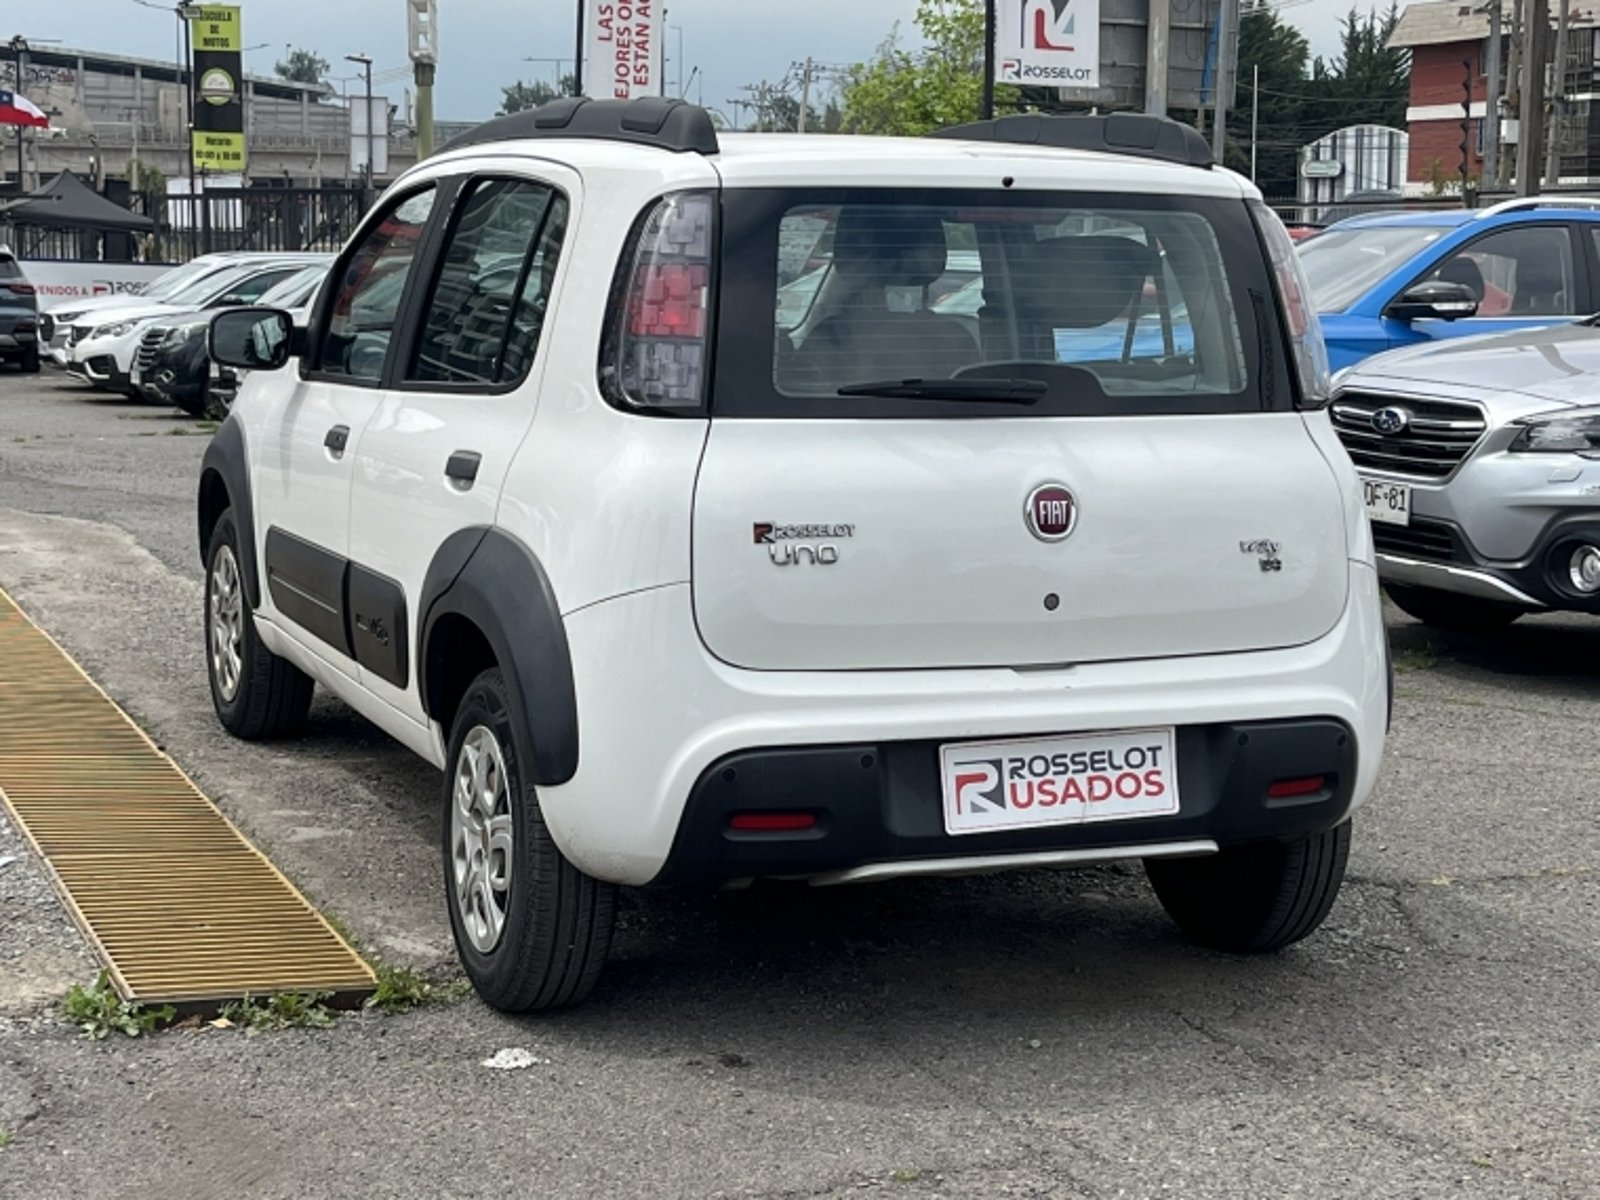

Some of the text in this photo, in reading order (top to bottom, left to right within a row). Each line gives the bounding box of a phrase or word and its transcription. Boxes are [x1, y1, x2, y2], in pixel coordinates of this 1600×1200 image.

[210, 24, 219, 34] DE
[598, 5, 613, 41] LAS
[632, 0, 651, 85] ESTÁN A
[1023, 65, 1091, 80] ROSSELOT
[1040, 500, 1068, 525] FIAT
[1008, 746, 1163, 779] ROSSELOT
[1010, 770, 1165, 809] USADOS
